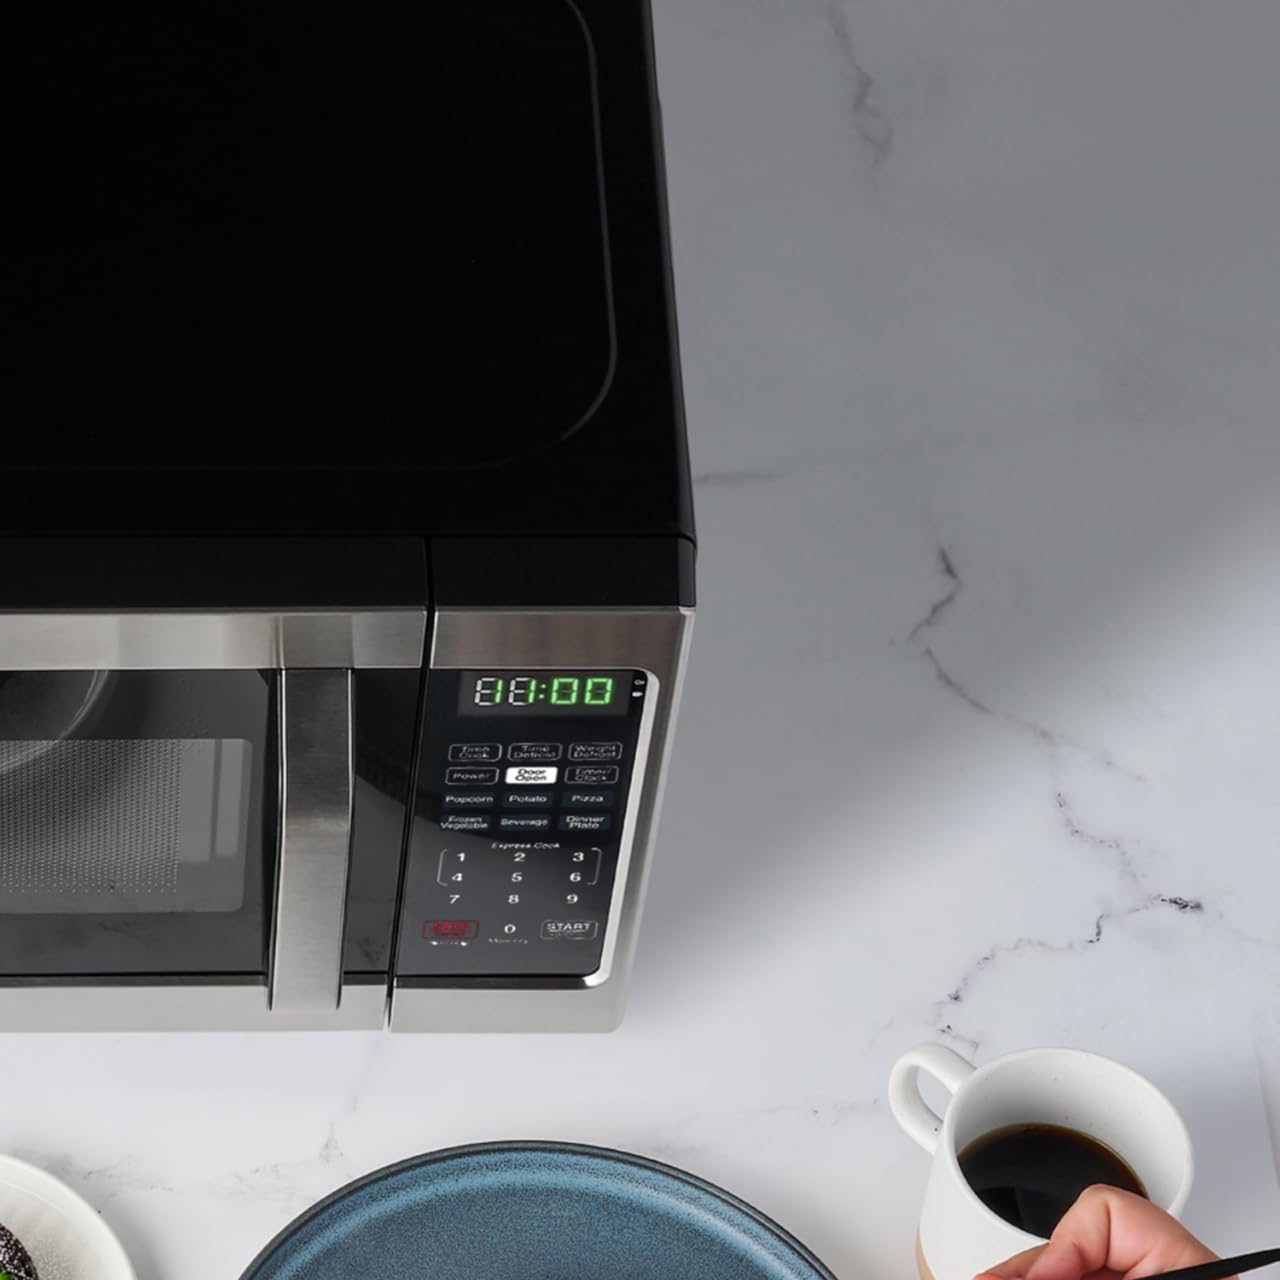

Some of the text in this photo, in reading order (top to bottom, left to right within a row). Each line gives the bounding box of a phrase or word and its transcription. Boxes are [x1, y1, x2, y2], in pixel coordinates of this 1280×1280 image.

[453, 772, 491, 780] Power
[515, 774, 547, 782] Open
[445, 795, 494, 804] Popcorn
[508, 795, 548, 803] Potato
[571, 795, 604, 803] Pizza
[500, 818, 548, 827] Beverage
[457, 852, 466, 862] 1
[513, 852, 526, 862] 2
[572, 852, 584, 862] 3
[451, 872, 463, 882] 4
[511, 872, 523, 882] 5
[570, 872, 581, 882] 6
[449, 895, 461, 904] 7
[508, 894, 520, 904] 8
[566, 894, 578, 904] 9
[504, 924, 516, 934] 0
[546, 922, 590, 931] START
